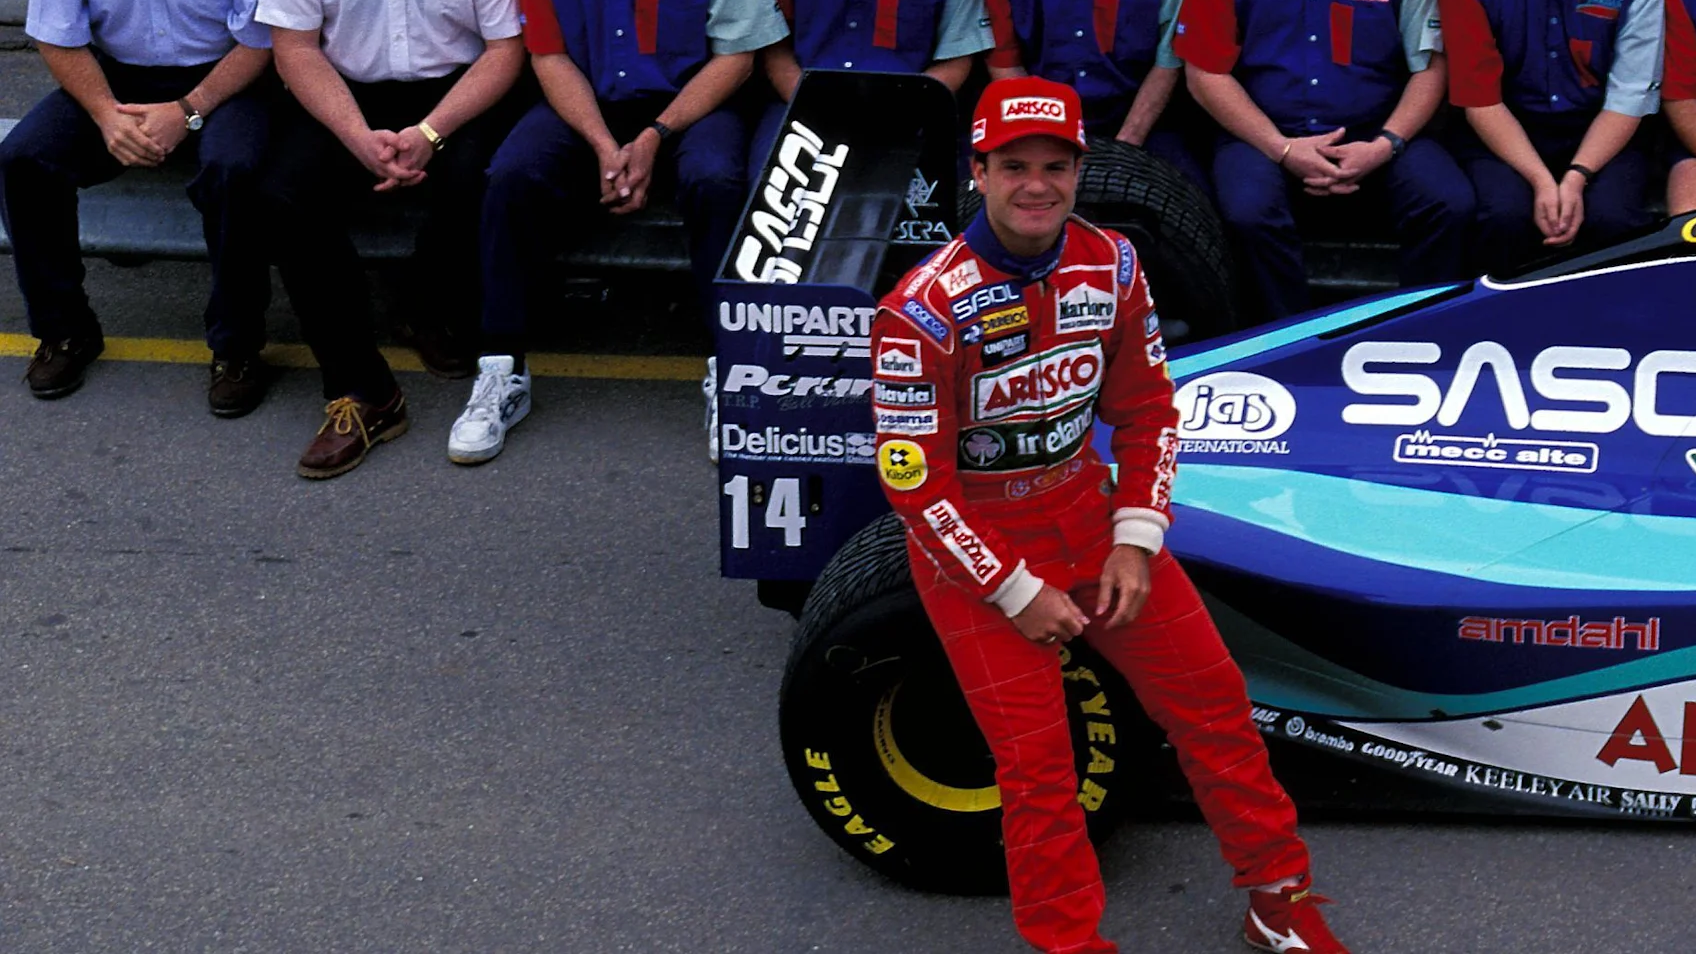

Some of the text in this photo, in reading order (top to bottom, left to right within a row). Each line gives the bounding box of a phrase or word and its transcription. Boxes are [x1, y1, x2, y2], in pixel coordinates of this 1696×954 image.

[1006, 101, 1061, 117] ARISCO
[720, 302, 876, 335] UNIPART
[984, 354, 1099, 411] ARISCO
[1183, 384, 1278, 431] jas
[722, 424, 845, 457] Delicius
[1405, 442, 1587, 466] mecc alte
[886, 467, 921, 480] Kibon
[723, 474, 806, 549] 14
[1458, 615, 1660, 650] amdahl
[1305, 726, 1355, 752] brembo
[1361, 742, 1459, 777] GOODYEAR
[1568, 780, 1613, 805] AIR
[805, 748, 896, 856] EAGLE
